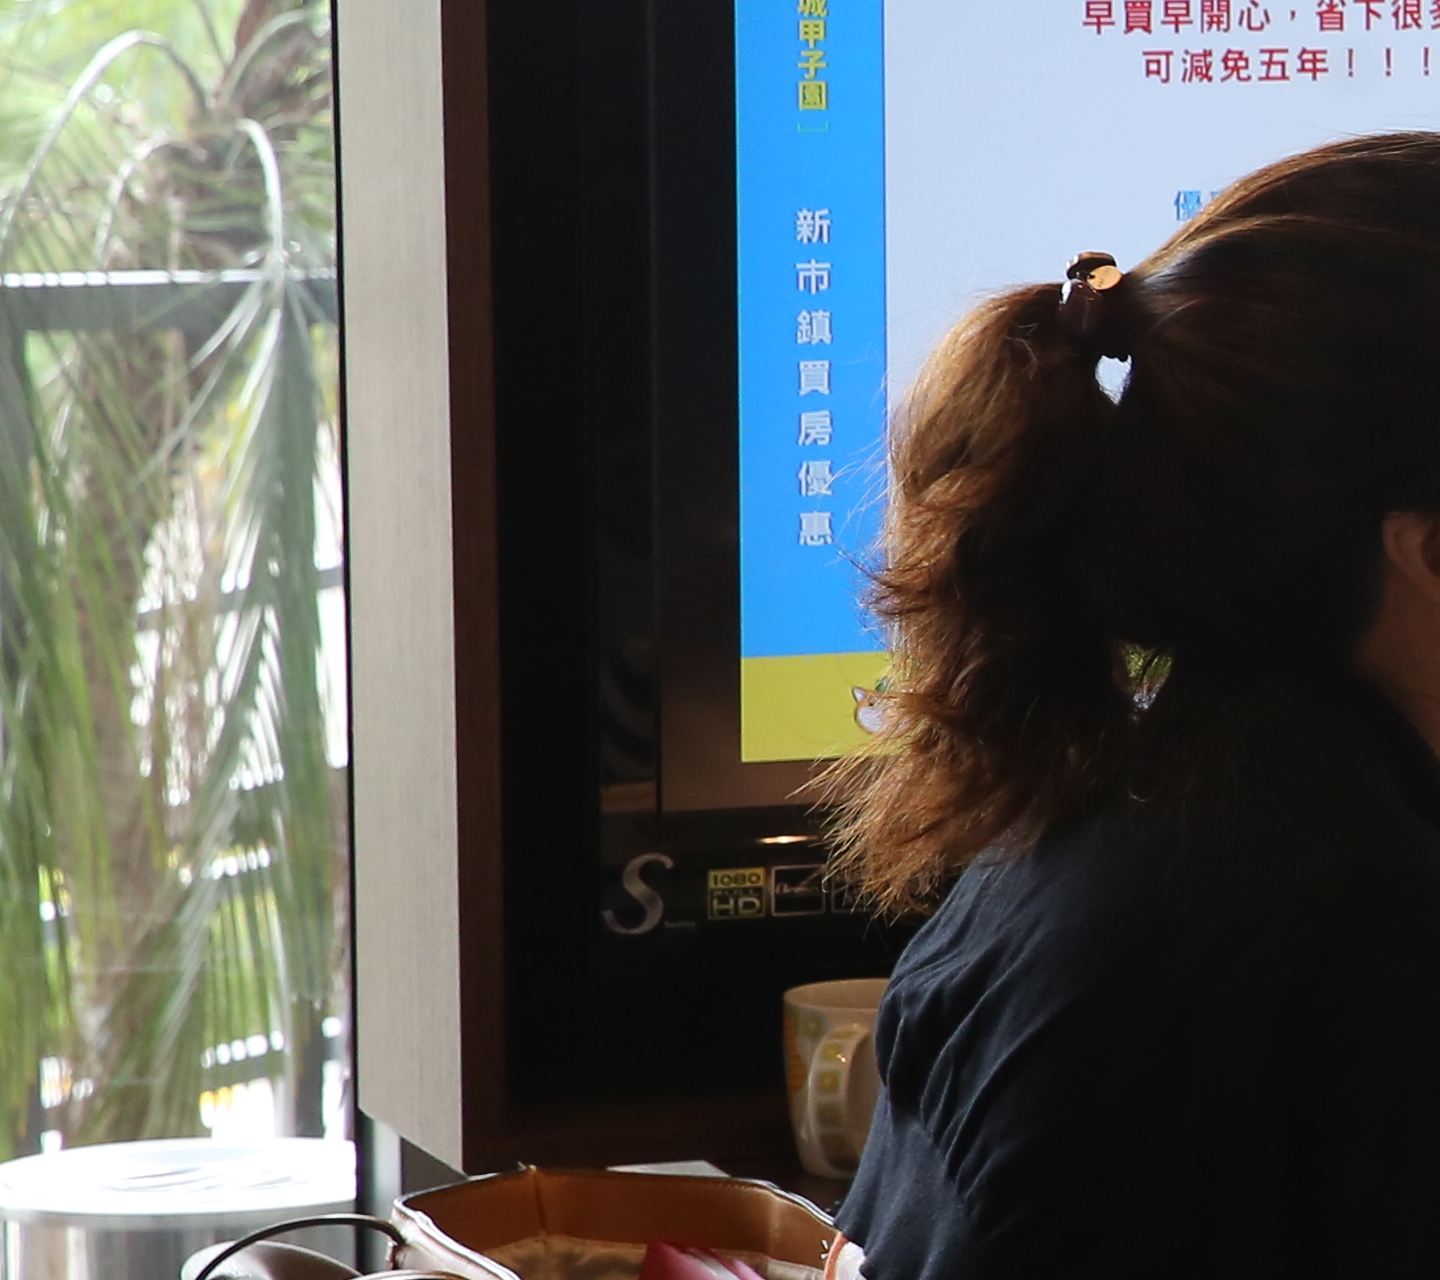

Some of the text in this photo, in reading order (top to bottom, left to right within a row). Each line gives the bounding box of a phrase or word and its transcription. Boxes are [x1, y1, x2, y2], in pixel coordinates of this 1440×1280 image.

[1142, 47, 1434, 84] 可減免五年！！！
[796, 208, 833, 546] 新市鎮買房優惠
[603, 853, 675, 935] S
[712, 898, 761, 915] HD
